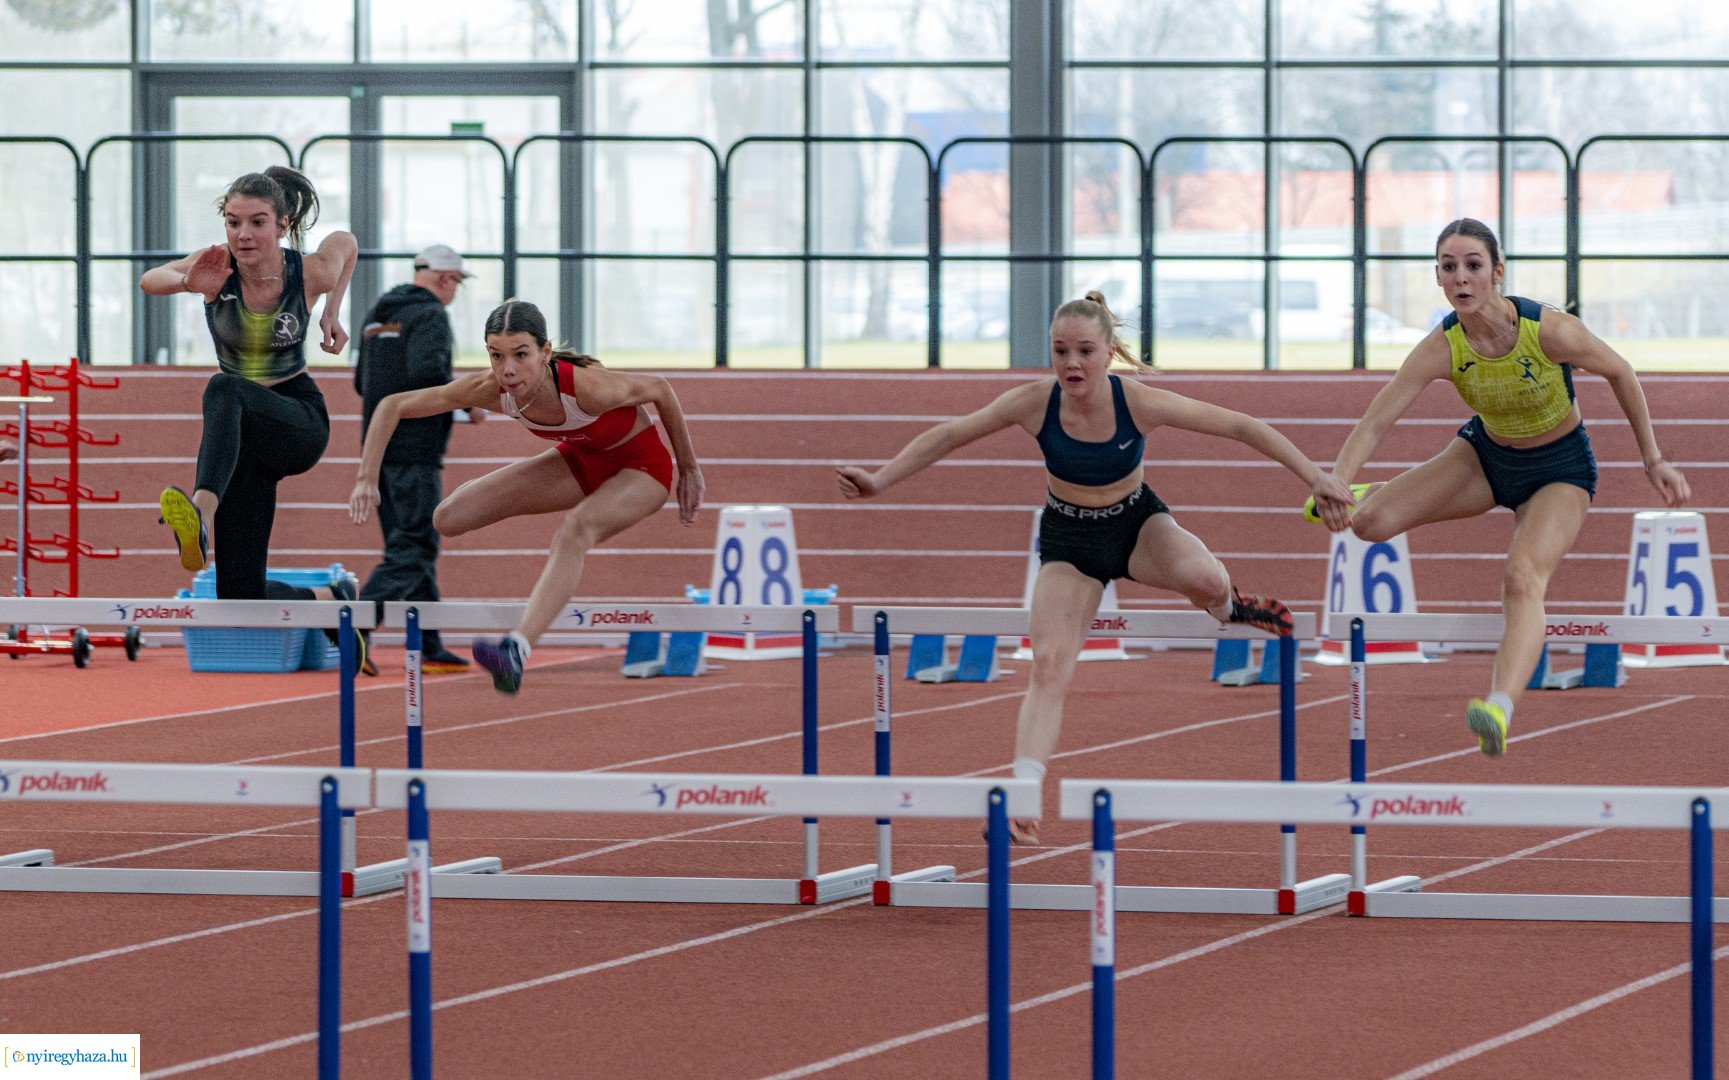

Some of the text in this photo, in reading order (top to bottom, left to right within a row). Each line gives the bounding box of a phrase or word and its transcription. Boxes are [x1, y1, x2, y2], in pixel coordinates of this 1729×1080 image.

[1079, 503, 1124, 519] PRO
[718, 536, 743, 605] 8
[760, 536, 793, 605] 8
[1330, 541, 1347, 612] 6
[1362, 541, 1402, 613] 6
[1630, 542, 1649, 616] 5
[1665, 542, 1704, 616] 5
[132, 604, 195, 622] polanik
[590, 605, 654, 626] polanik
[1091, 616, 1128, 630] anik
[1544, 621, 1610, 638] polanik
[408, 669, 417, 707] polanik
[876, 674, 886, 712] polanik
[1351, 681, 1362, 720] polanik
[18, 770, 109, 796] polanik
[676, 785, 769, 809] polanik
[1370, 795, 1466, 819] polanik
